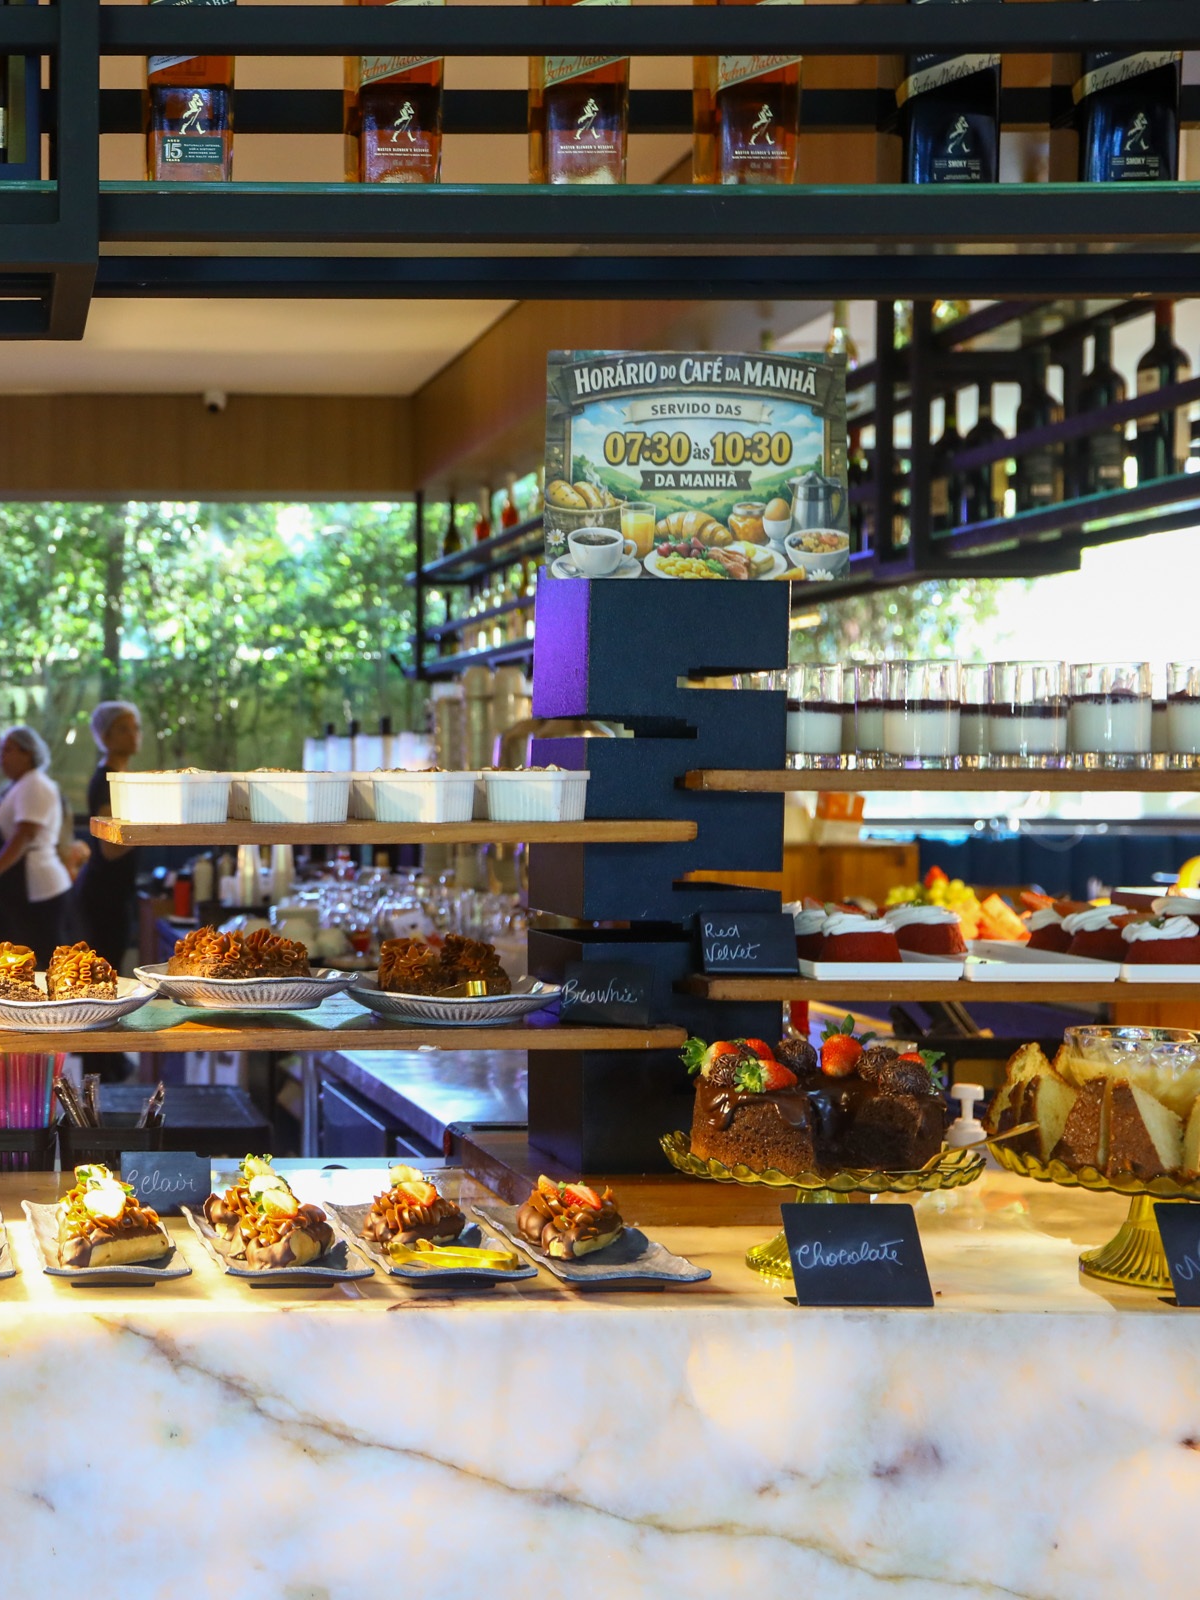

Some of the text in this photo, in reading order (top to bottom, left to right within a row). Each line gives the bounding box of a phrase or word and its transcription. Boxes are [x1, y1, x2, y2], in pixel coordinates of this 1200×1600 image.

[163, 143, 183, 158] 15
[947, 160, 967, 168] SMOKY
[1126, 157, 1146, 165] SMOKY
[574, 357, 817, 396] HORÁRIO DO CAFÉ DA MANHÃ
[651, 402, 742, 416] SERVIDO DAS
[604, 431, 793, 466] 07:30 às 10:30
[654, 471, 738, 487] DA MANHÃ
[705, 922, 741, 939] Red
[705, 942, 762, 962] Velvet
[795, 1239, 905, 1270] Chocolate
